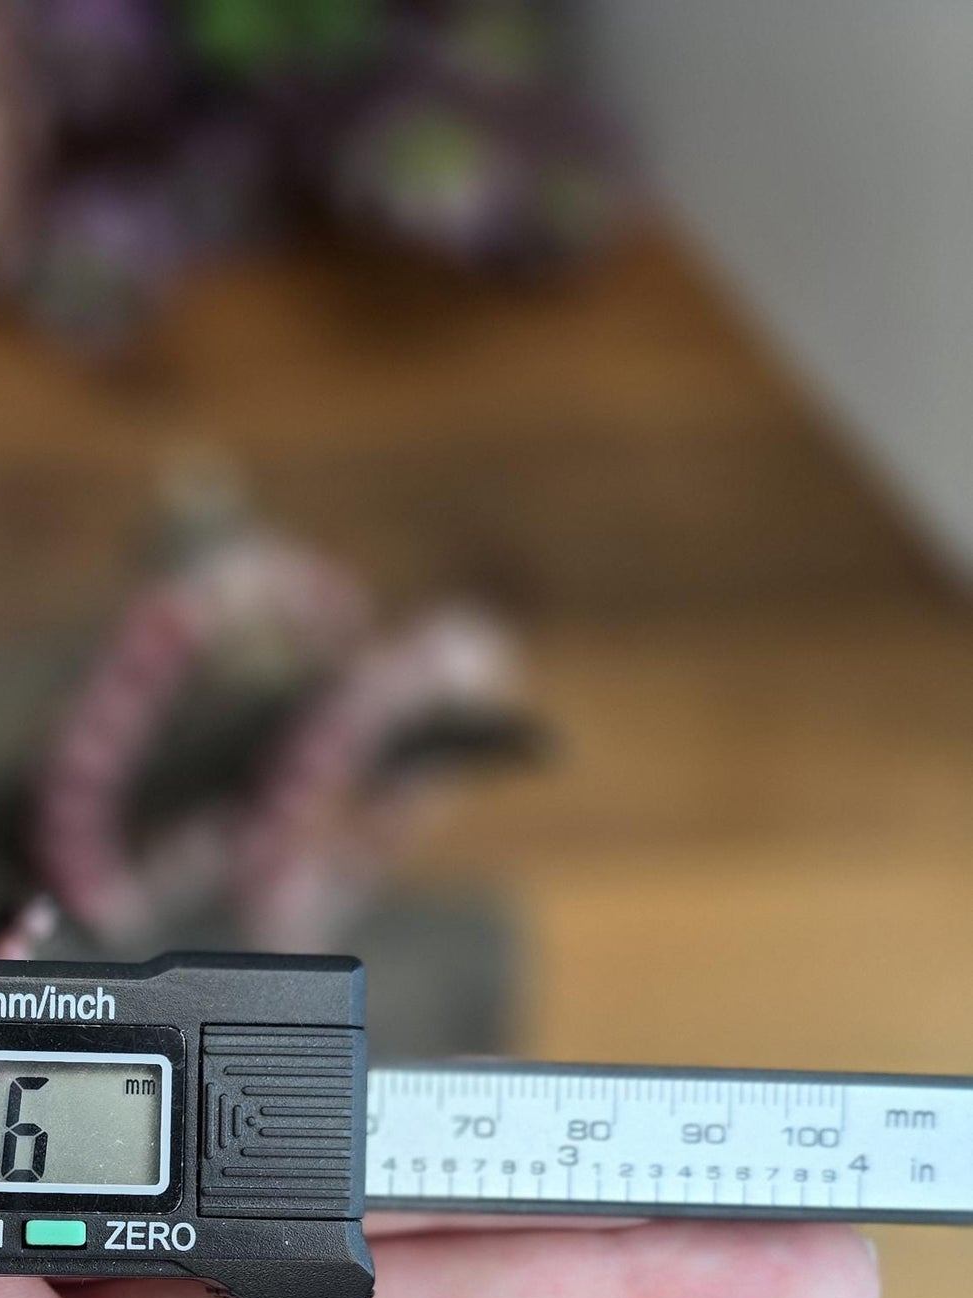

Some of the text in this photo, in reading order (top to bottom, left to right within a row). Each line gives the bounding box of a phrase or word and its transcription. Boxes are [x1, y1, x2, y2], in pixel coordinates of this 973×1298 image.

[125, 1078, 156, 1096] mm
[452, 1109, 935, 1148] 70 80 90 100 mm
[381, 1146, 936, 1183] 4 5 6 7 8 9 3 1 2 3 4 5 6 7 8 9 4 in
[104, 1221, 196, 1251] ZERO
